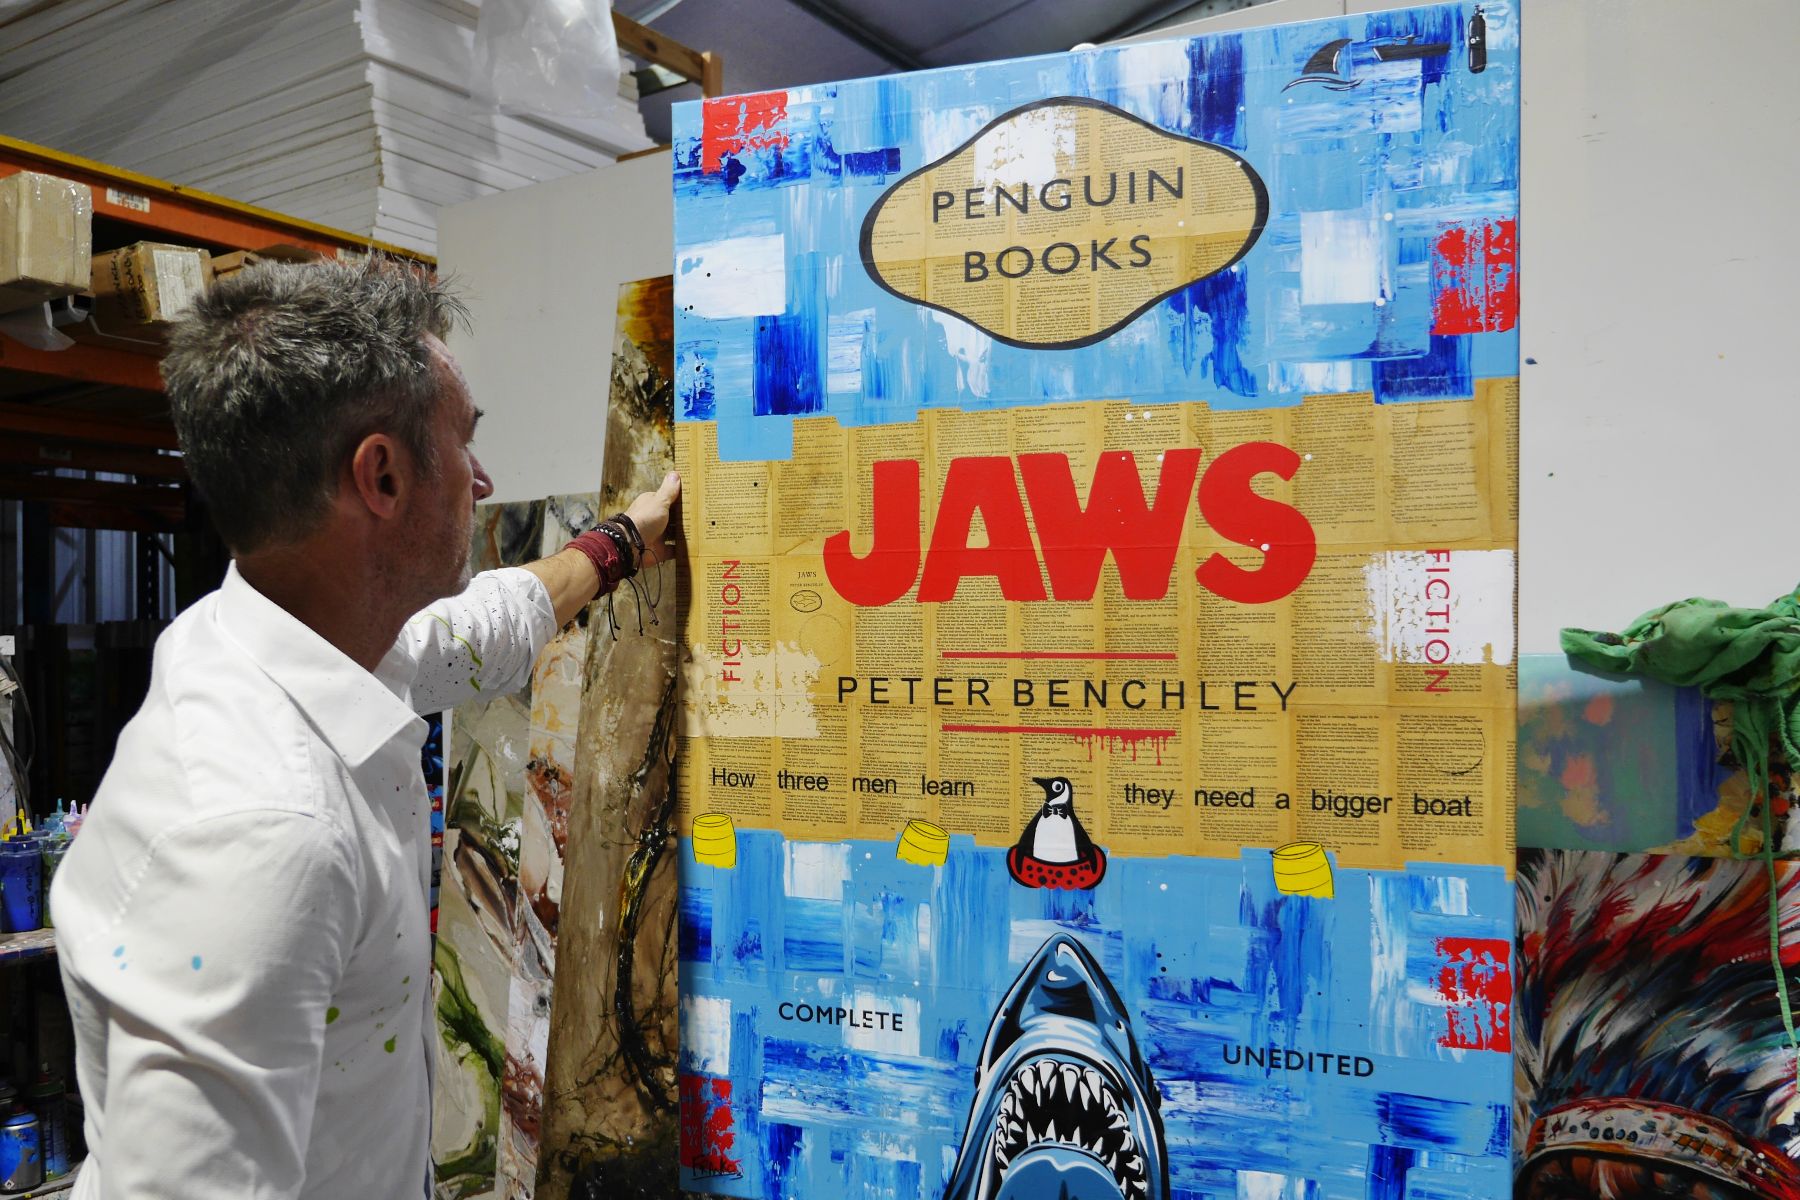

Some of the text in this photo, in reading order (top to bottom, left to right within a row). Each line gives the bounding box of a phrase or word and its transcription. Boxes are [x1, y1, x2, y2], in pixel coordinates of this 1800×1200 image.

[932, 166, 1184, 223] PENGUIN
[964, 234, 1152, 283] BOOKS
[822, 440, 1318, 607] JAWS
[797, 571, 818, 580] JAWS
[721, 559, 742, 683] FICTION
[1424, 547, 1452, 693] FICTION
[838, 676, 1298, 711] PETER BENCHLEY
[712, 767, 1474, 819] How three men learn they need a bigger boat
[778, 1002, 903, 1032] COMPLETE
[1222, 1043, 1374, 1078] UNEDITED
